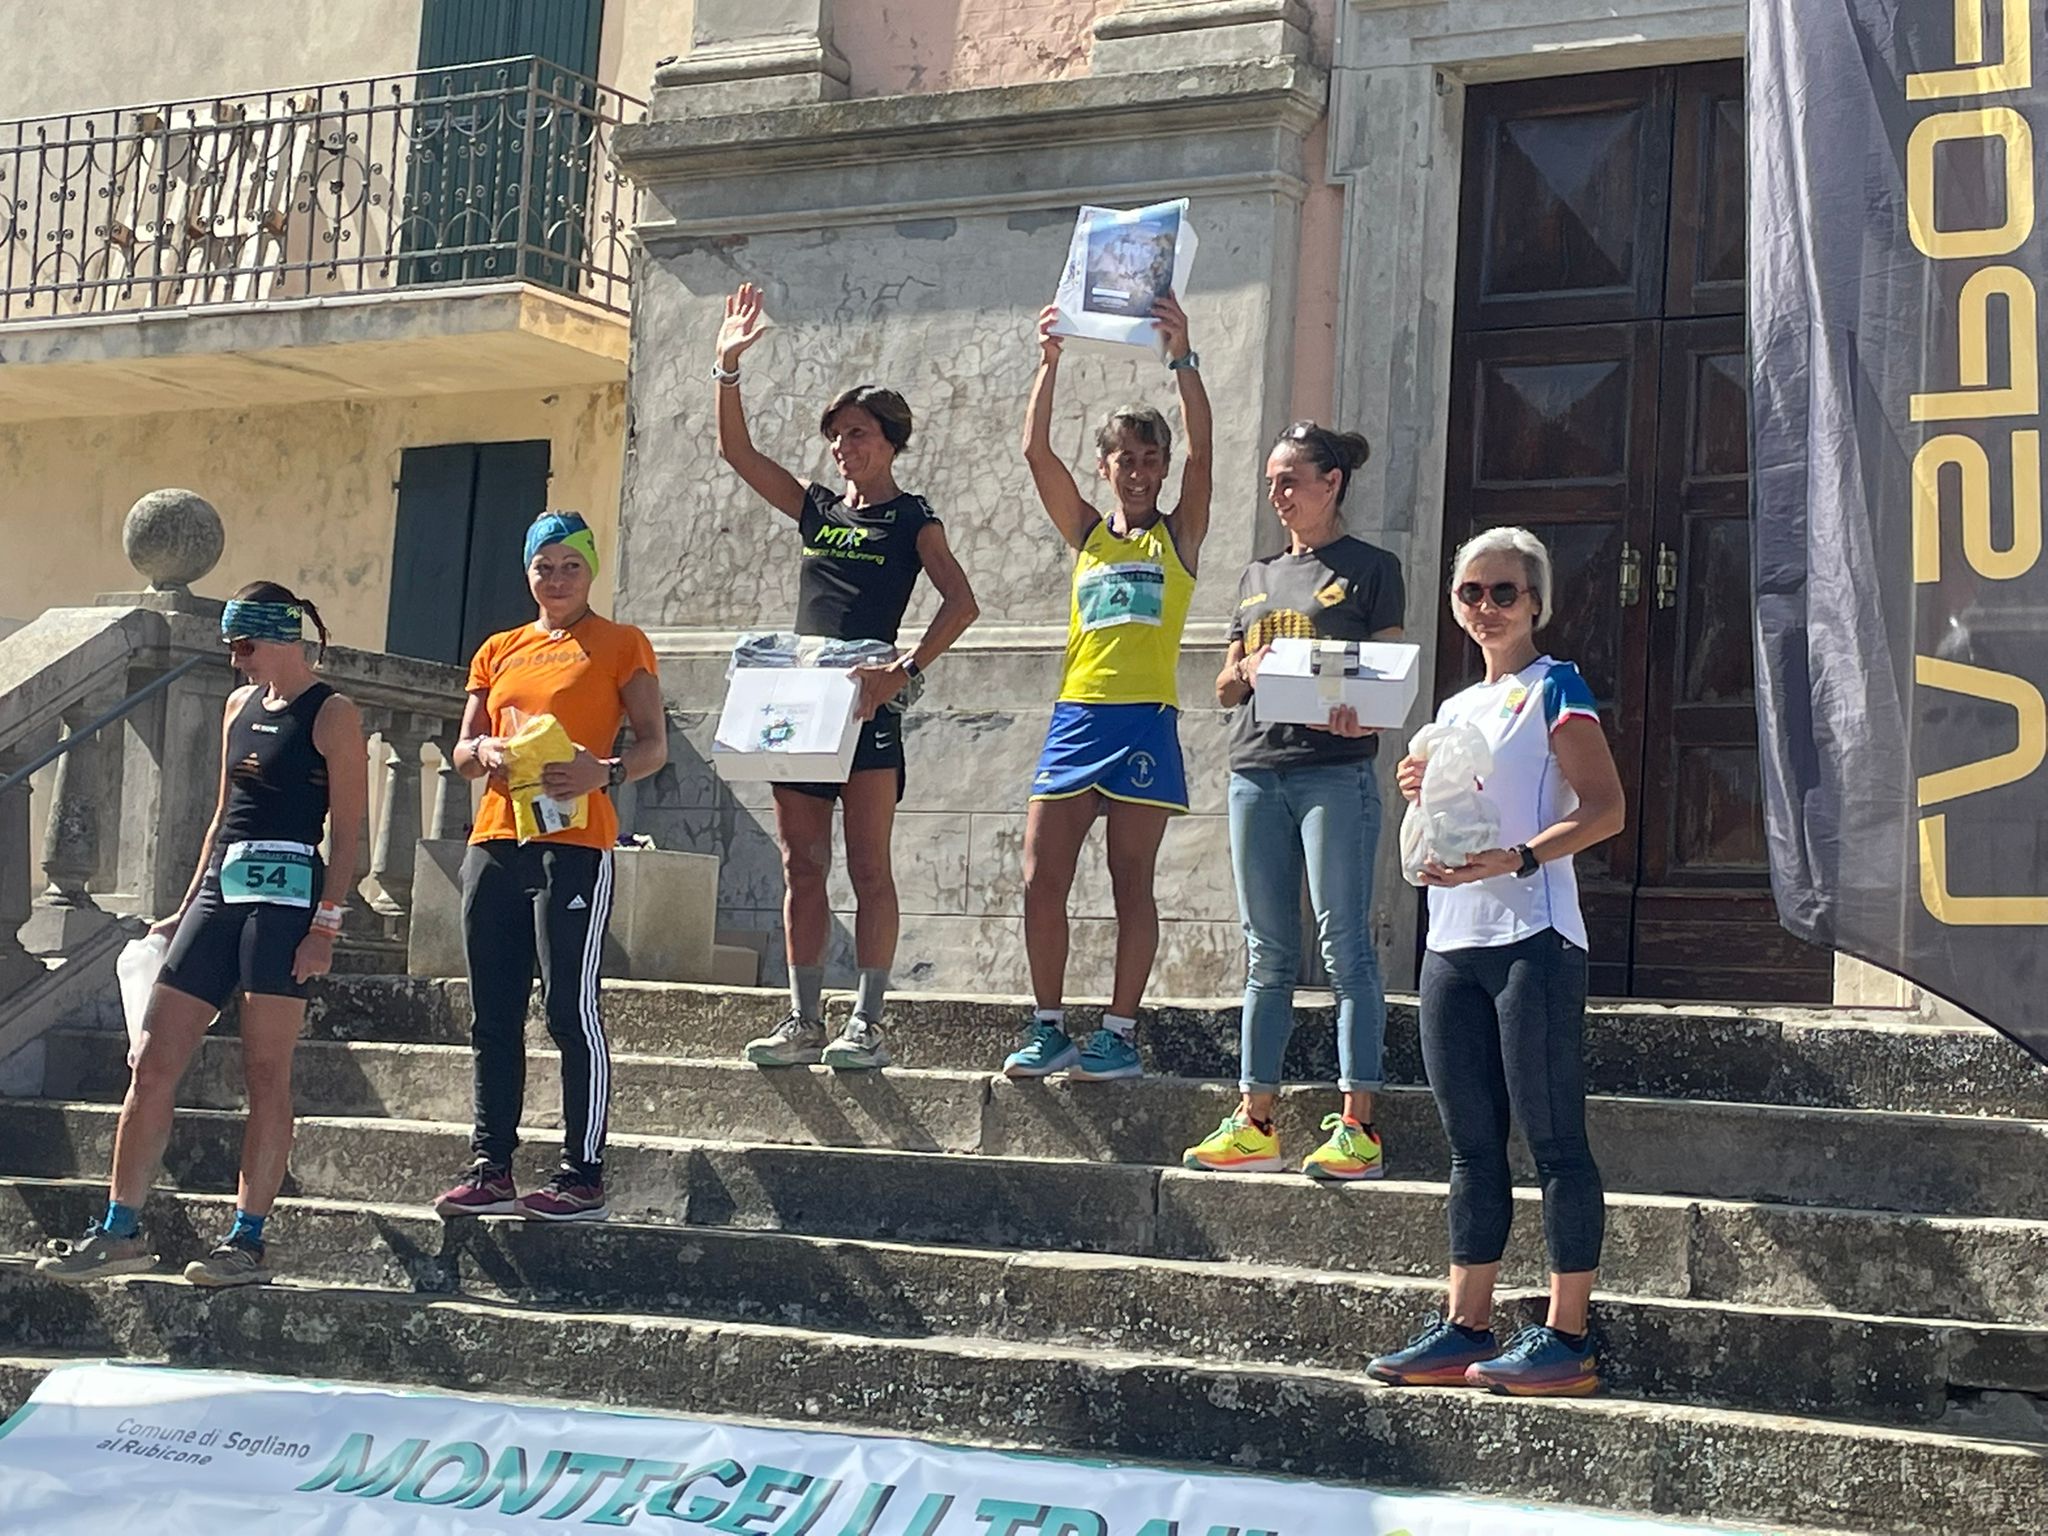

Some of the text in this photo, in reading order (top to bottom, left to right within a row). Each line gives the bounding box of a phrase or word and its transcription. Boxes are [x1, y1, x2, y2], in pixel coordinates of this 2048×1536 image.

[1110, 588, 1130, 607] 4
[246, 864, 287, 889] 54
[116, 1418, 312, 1459] Comune di Sogliano
[96, 1438, 213, 1466] al Rubicone
